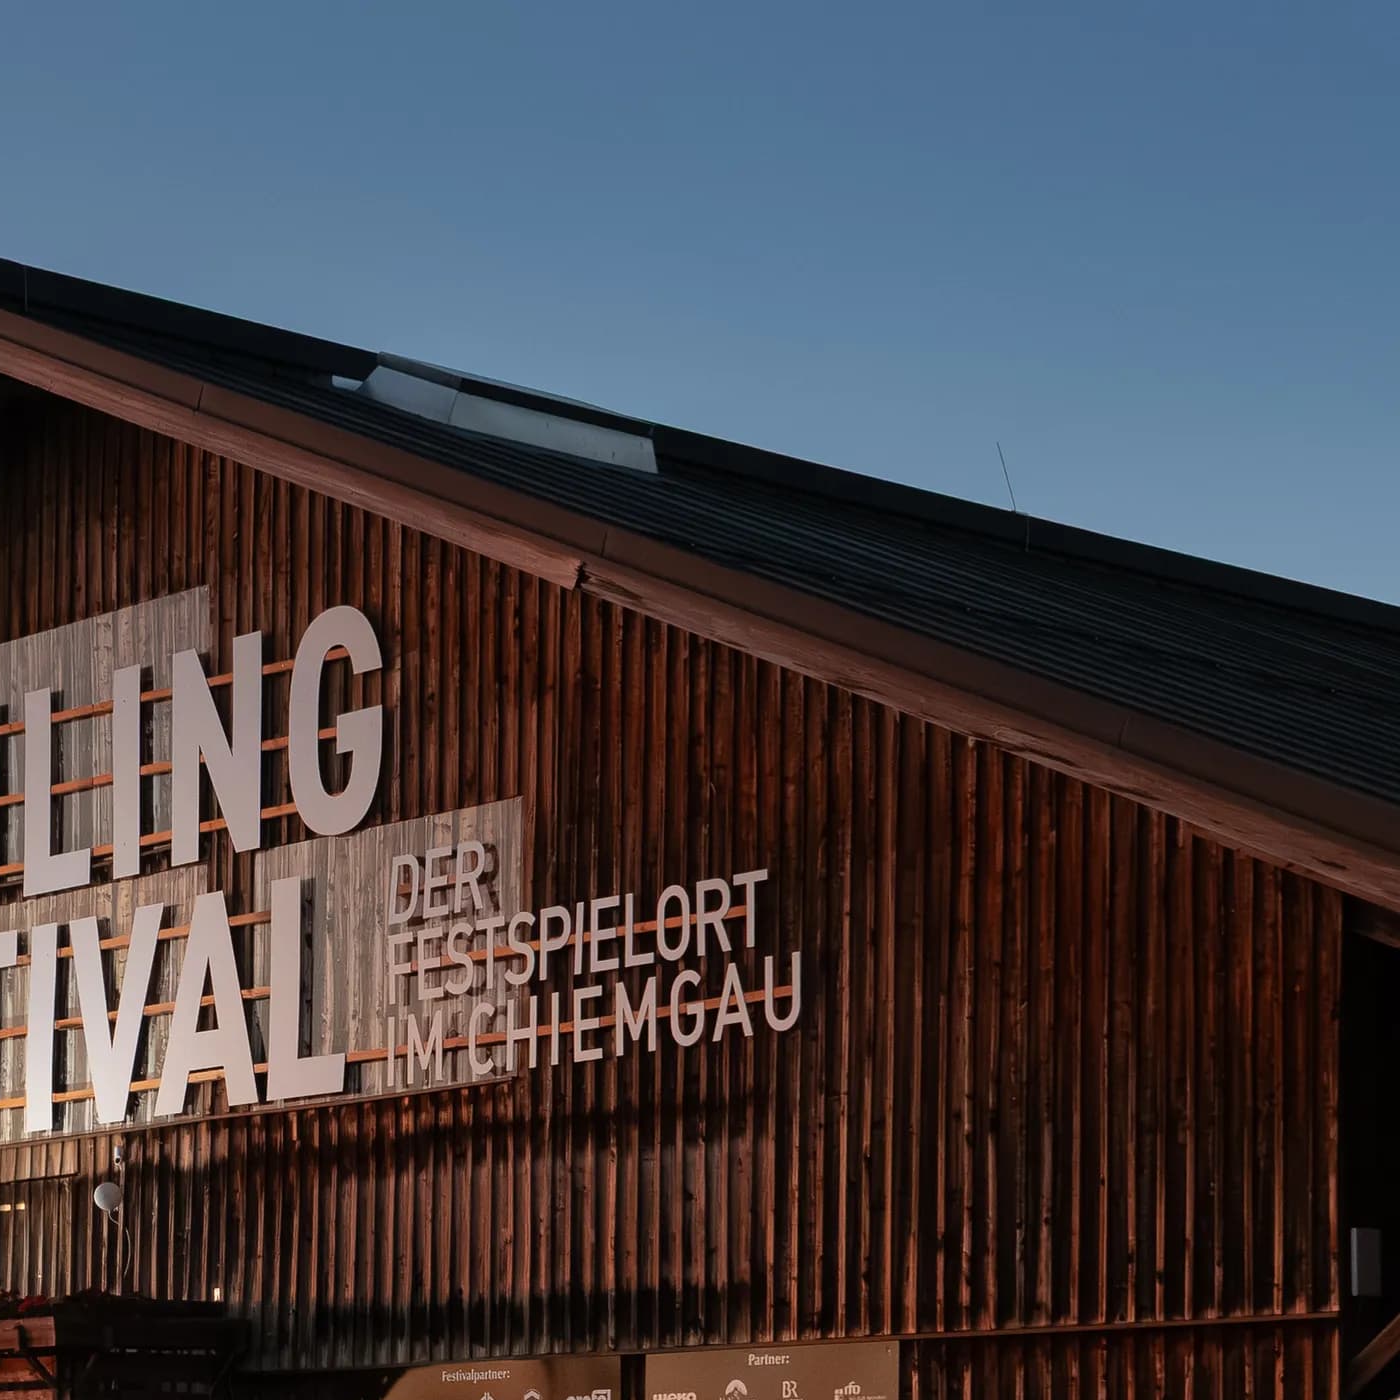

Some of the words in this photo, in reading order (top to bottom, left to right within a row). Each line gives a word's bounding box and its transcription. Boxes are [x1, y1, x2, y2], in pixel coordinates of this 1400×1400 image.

[388, 840, 486, 926] DER
[387, 868, 769, 1005] FESTSPIELORT
[386, 1009, 443, 1087] IM
[468, 950, 801, 1076] CHIEMGAU
[441, 1369, 511, 1384] Festivalpartner:
[748, 1353, 790, 1366] Partner:
[782, 1380, 799, 1398] BR
